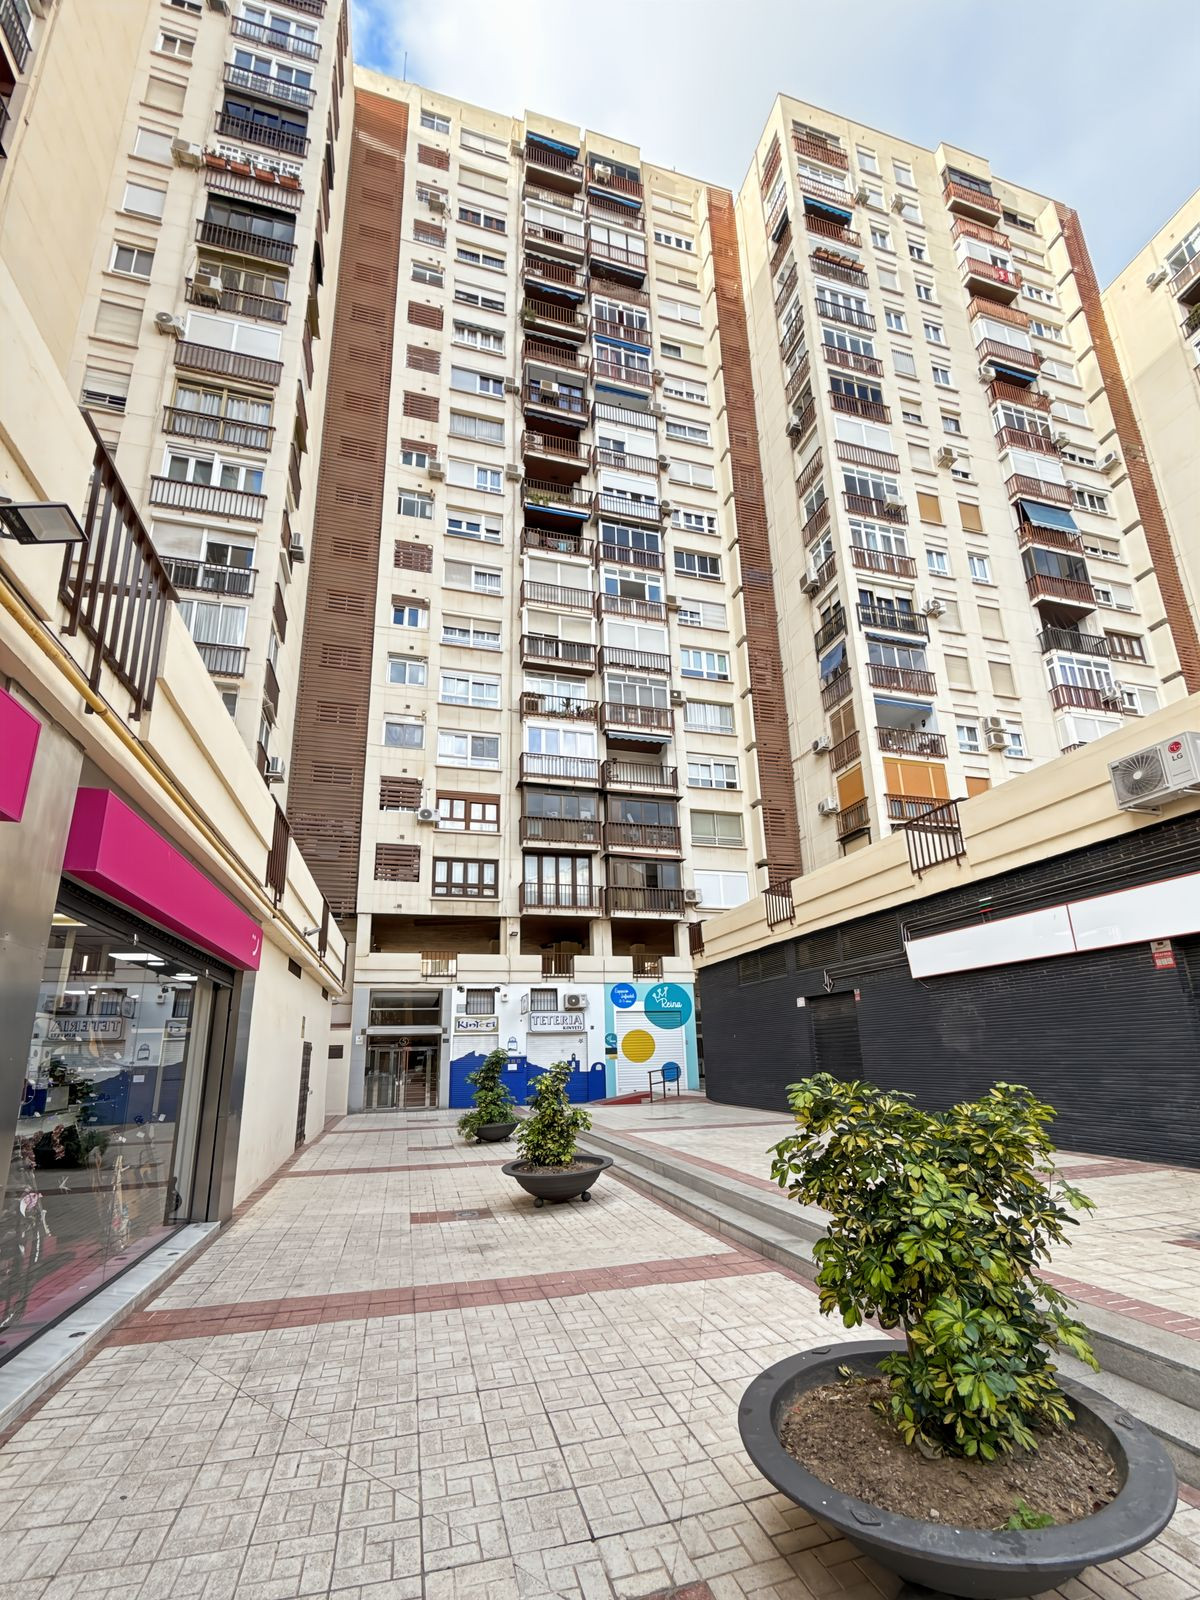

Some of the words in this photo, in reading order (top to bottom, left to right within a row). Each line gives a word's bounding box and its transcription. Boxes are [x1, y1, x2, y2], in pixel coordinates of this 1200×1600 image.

[1172, 752, 1184, 762] LG
[661, 998, 683, 1008] Reina
[531, 1015, 583, 1025] TETERIA
